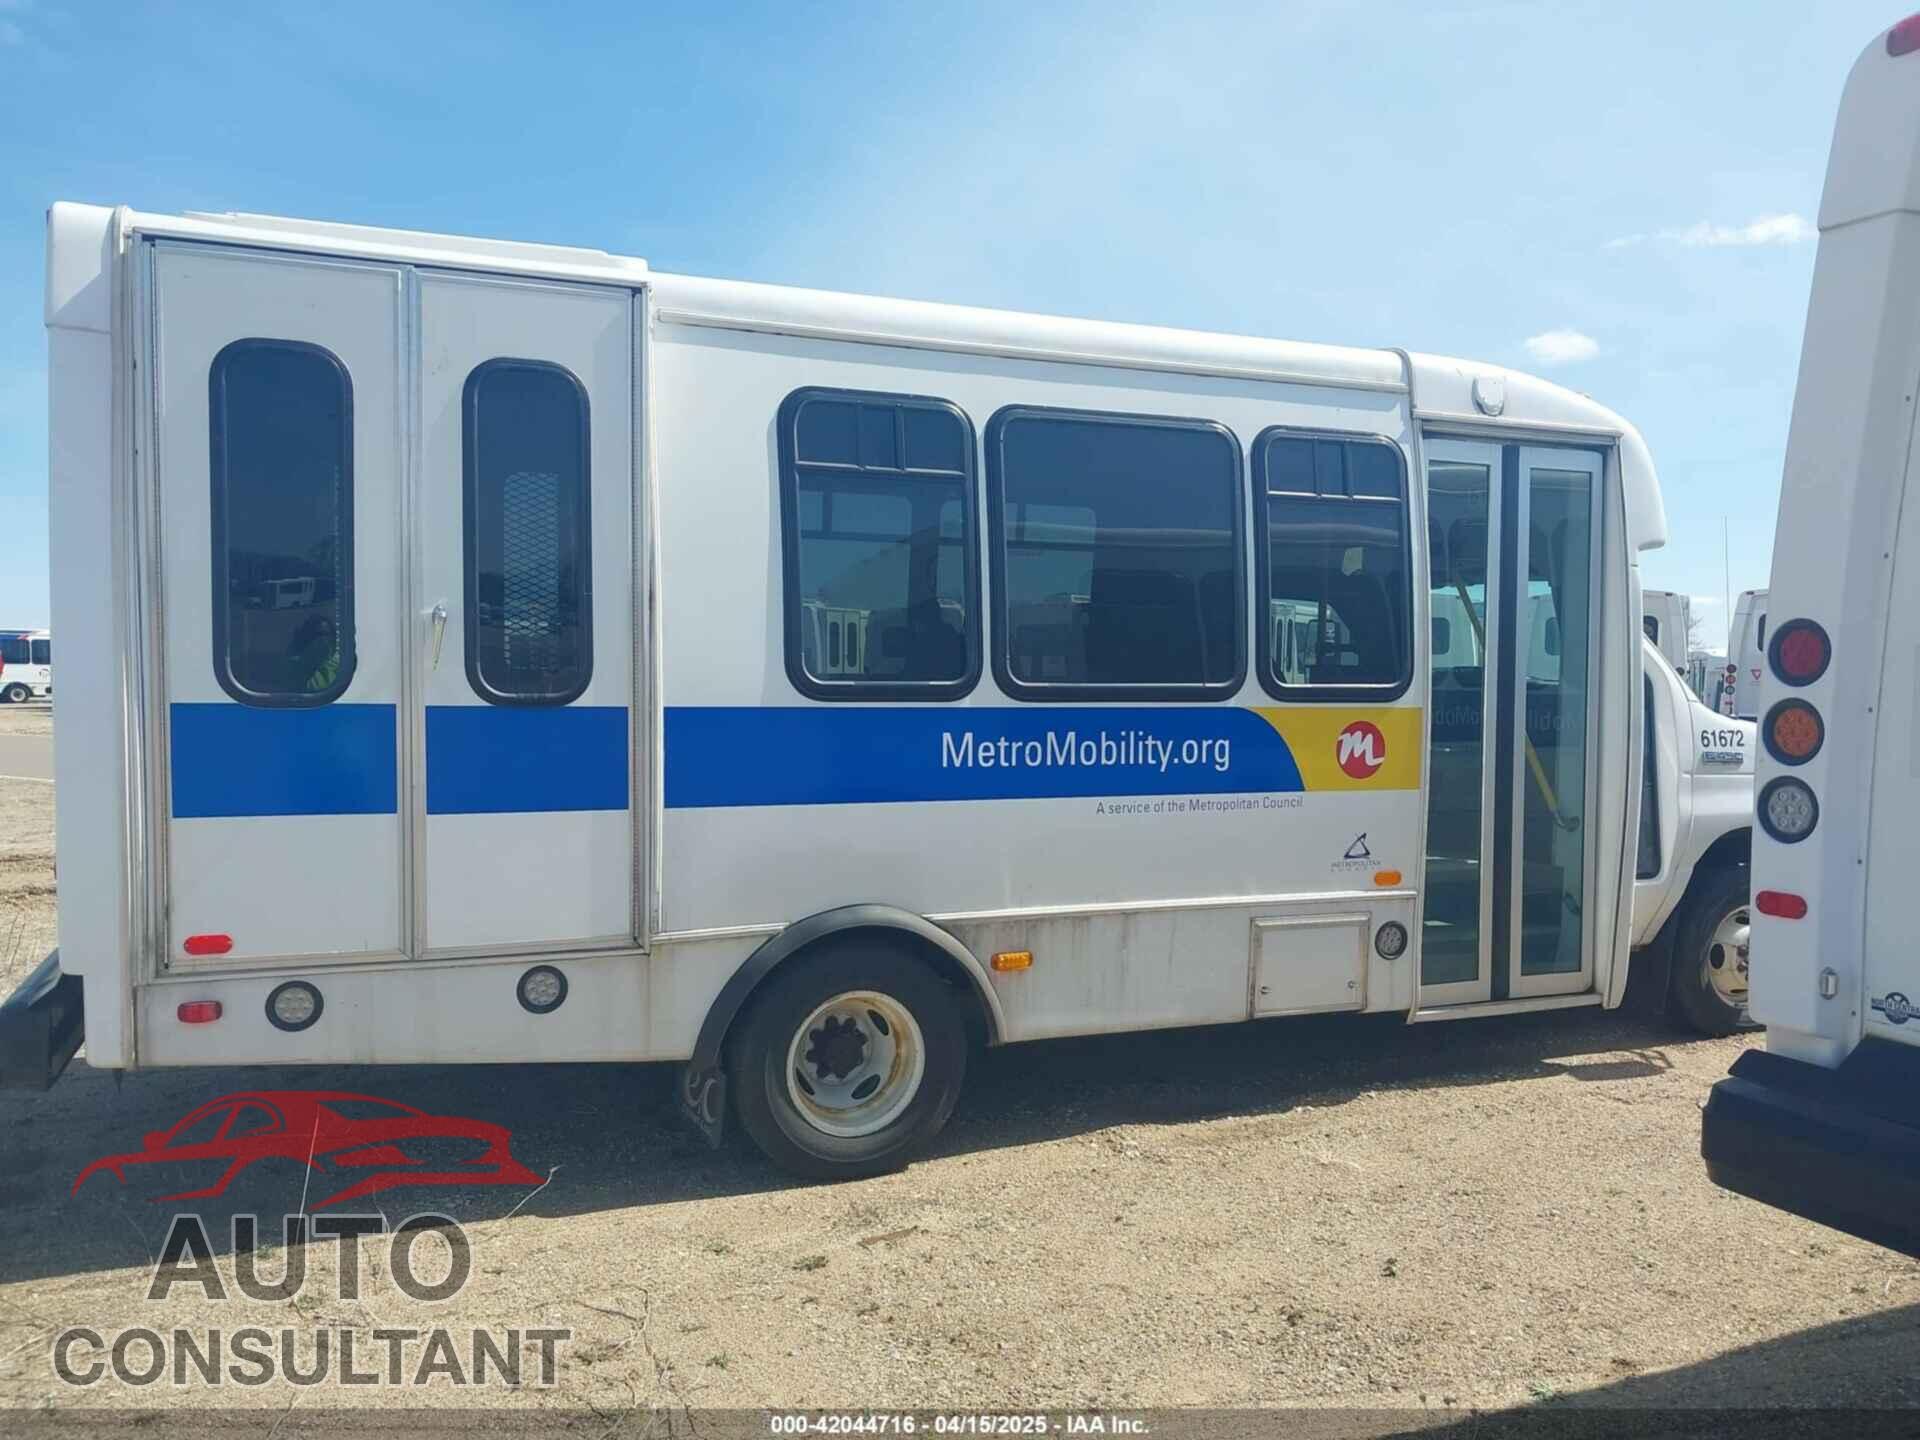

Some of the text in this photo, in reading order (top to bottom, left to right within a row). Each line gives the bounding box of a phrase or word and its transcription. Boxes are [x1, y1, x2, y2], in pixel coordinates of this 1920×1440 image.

[1701, 730, 1745, 747] 61672
[941, 731, 1231, 773] MetroMobility.org
[1096, 796, 1304, 815] A service of the Metropolitan Council
